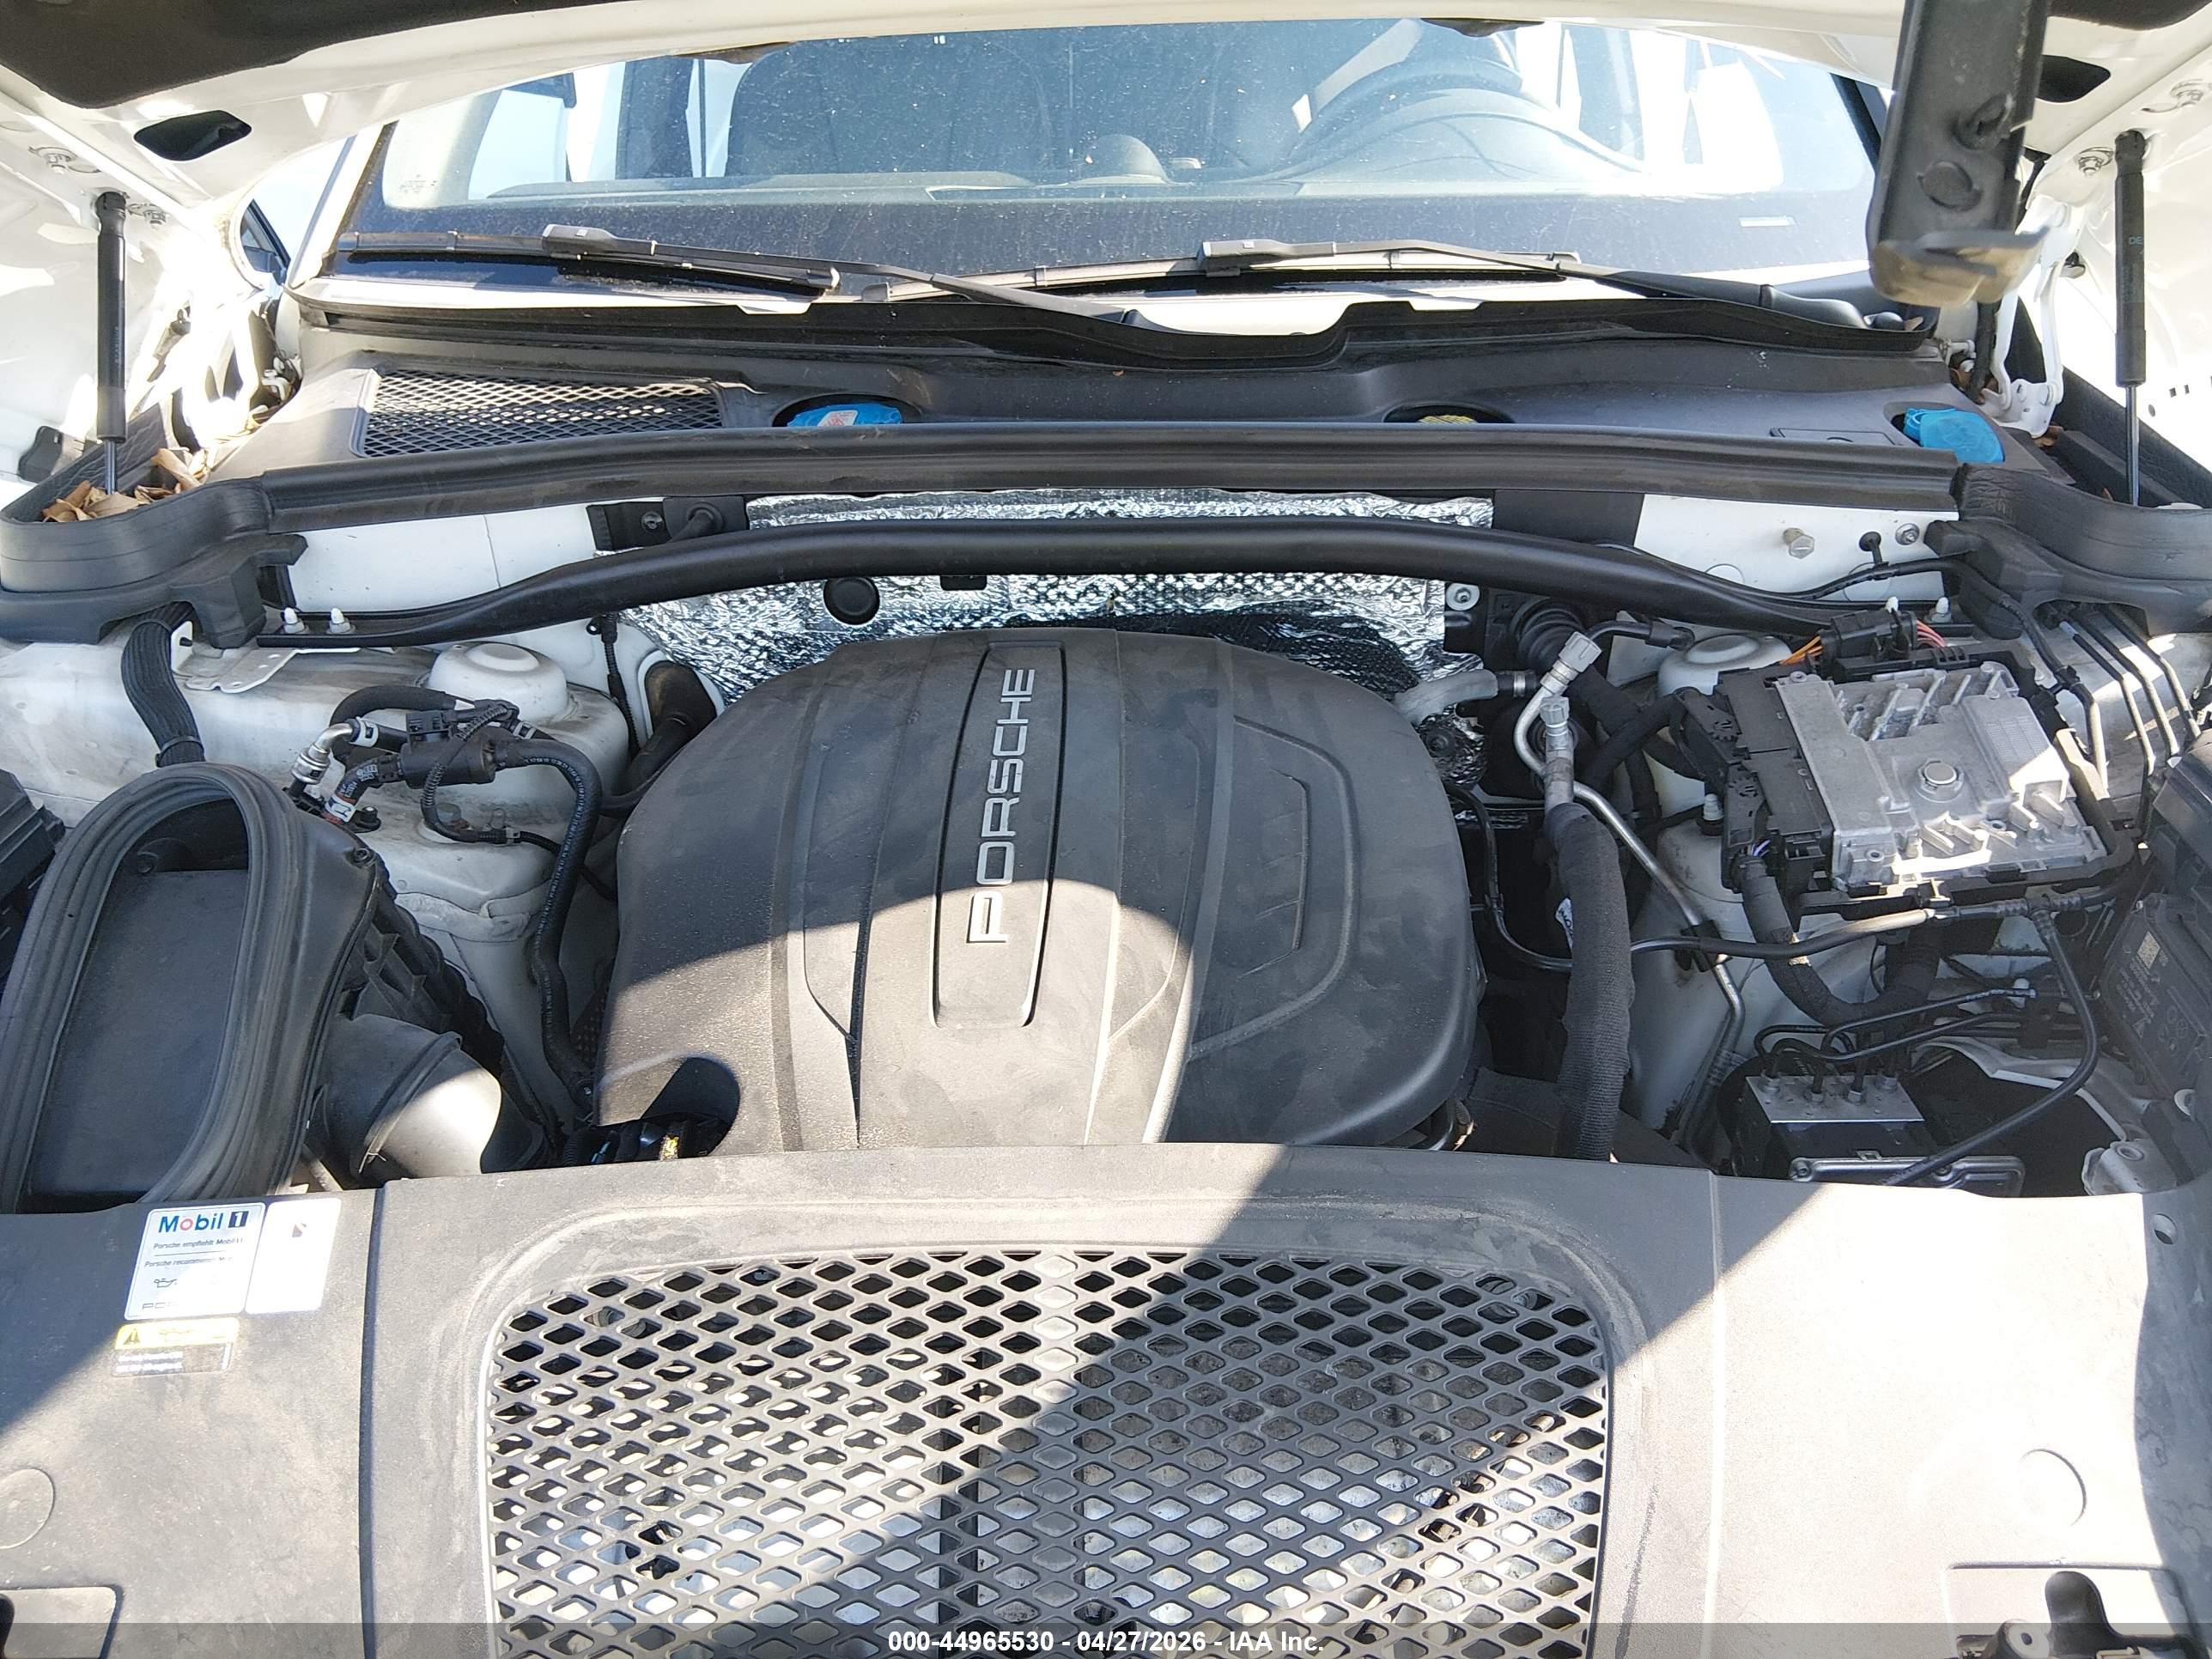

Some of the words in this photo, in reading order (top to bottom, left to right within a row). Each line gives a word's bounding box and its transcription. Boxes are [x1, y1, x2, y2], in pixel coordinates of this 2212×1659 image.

[966, 669, 1035, 943] PORSCHE
[158, 1212, 224, 1233] Mobil
[231, 1211, 246, 1228] 1
